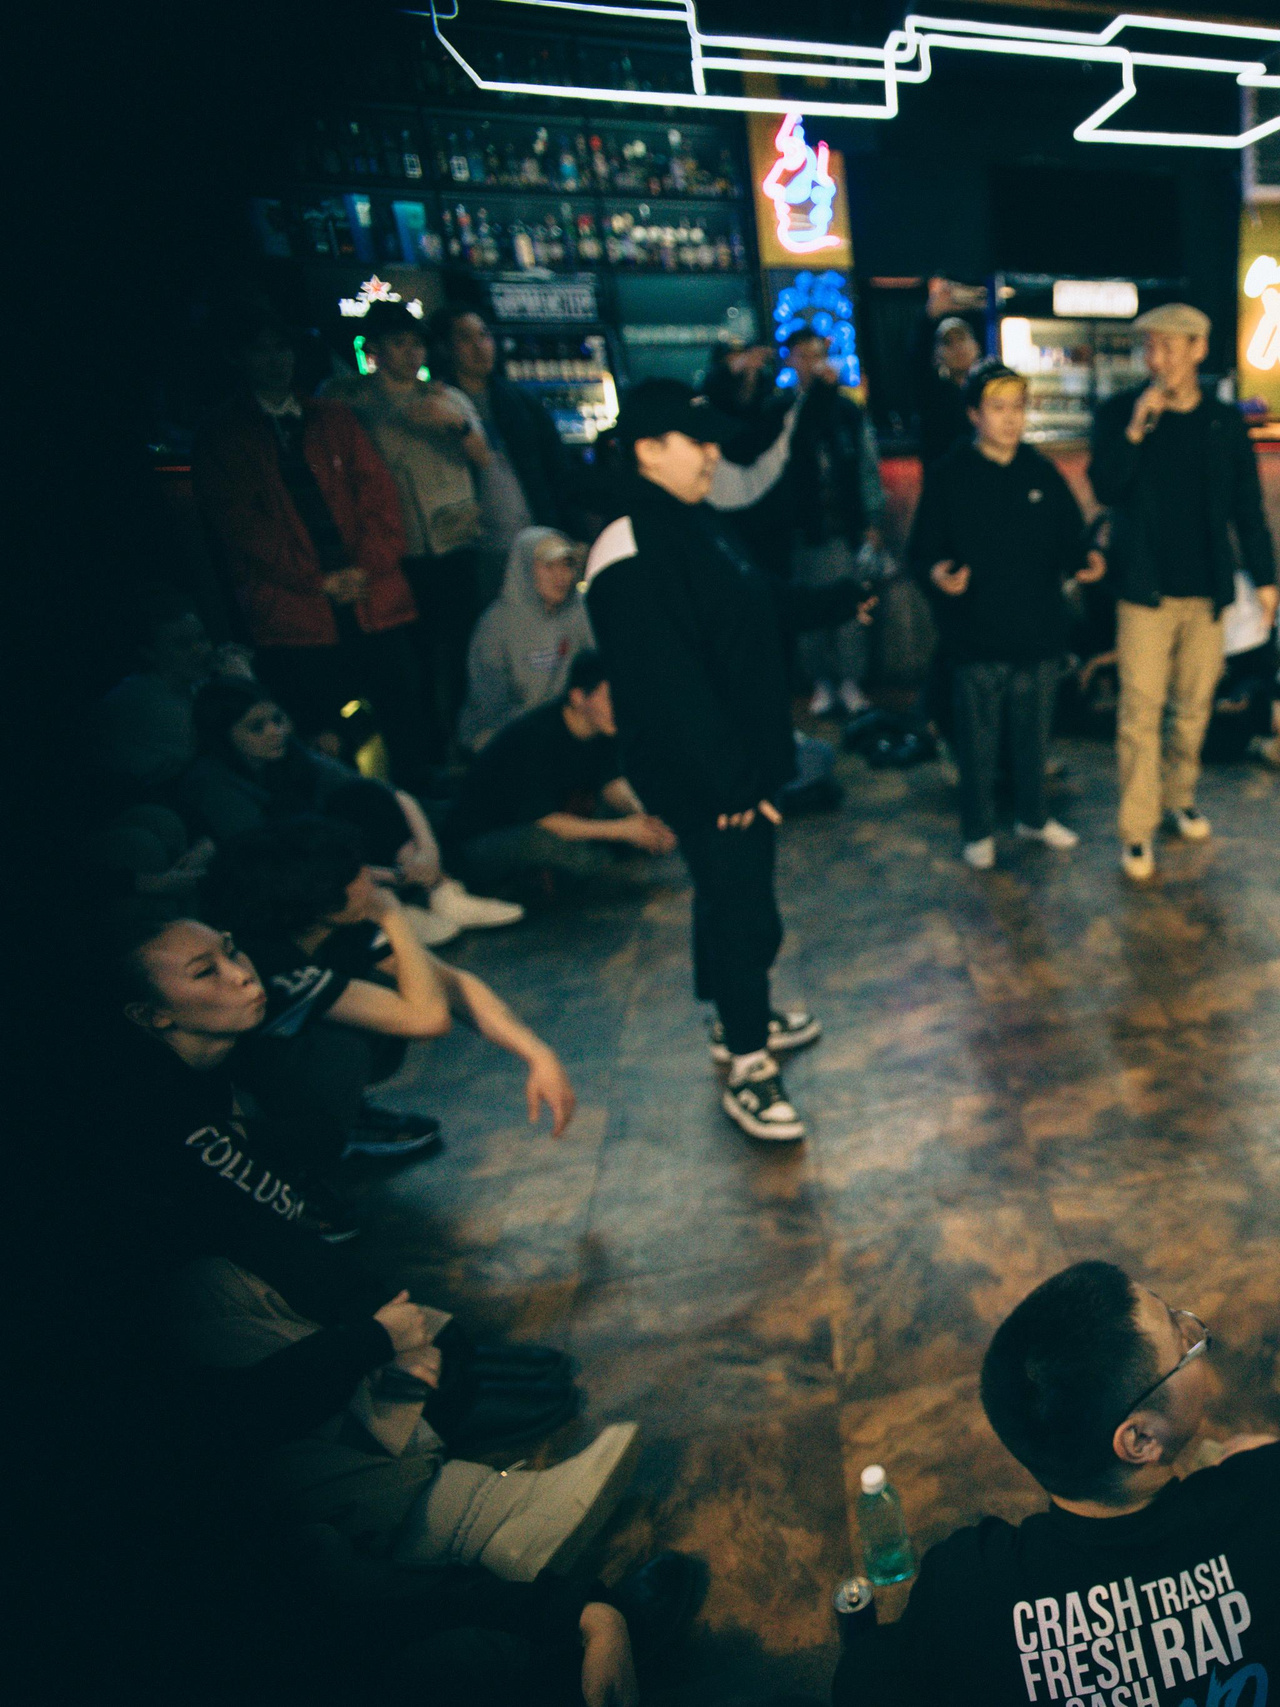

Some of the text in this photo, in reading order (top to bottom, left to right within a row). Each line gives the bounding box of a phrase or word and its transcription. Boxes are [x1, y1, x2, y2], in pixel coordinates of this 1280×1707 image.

[1012, 1554, 1235, 1653] CRASH TRASH
[1020, 1627, 1149, 1702] FRESH
[1150, 1590, 1251, 1689] RAP
